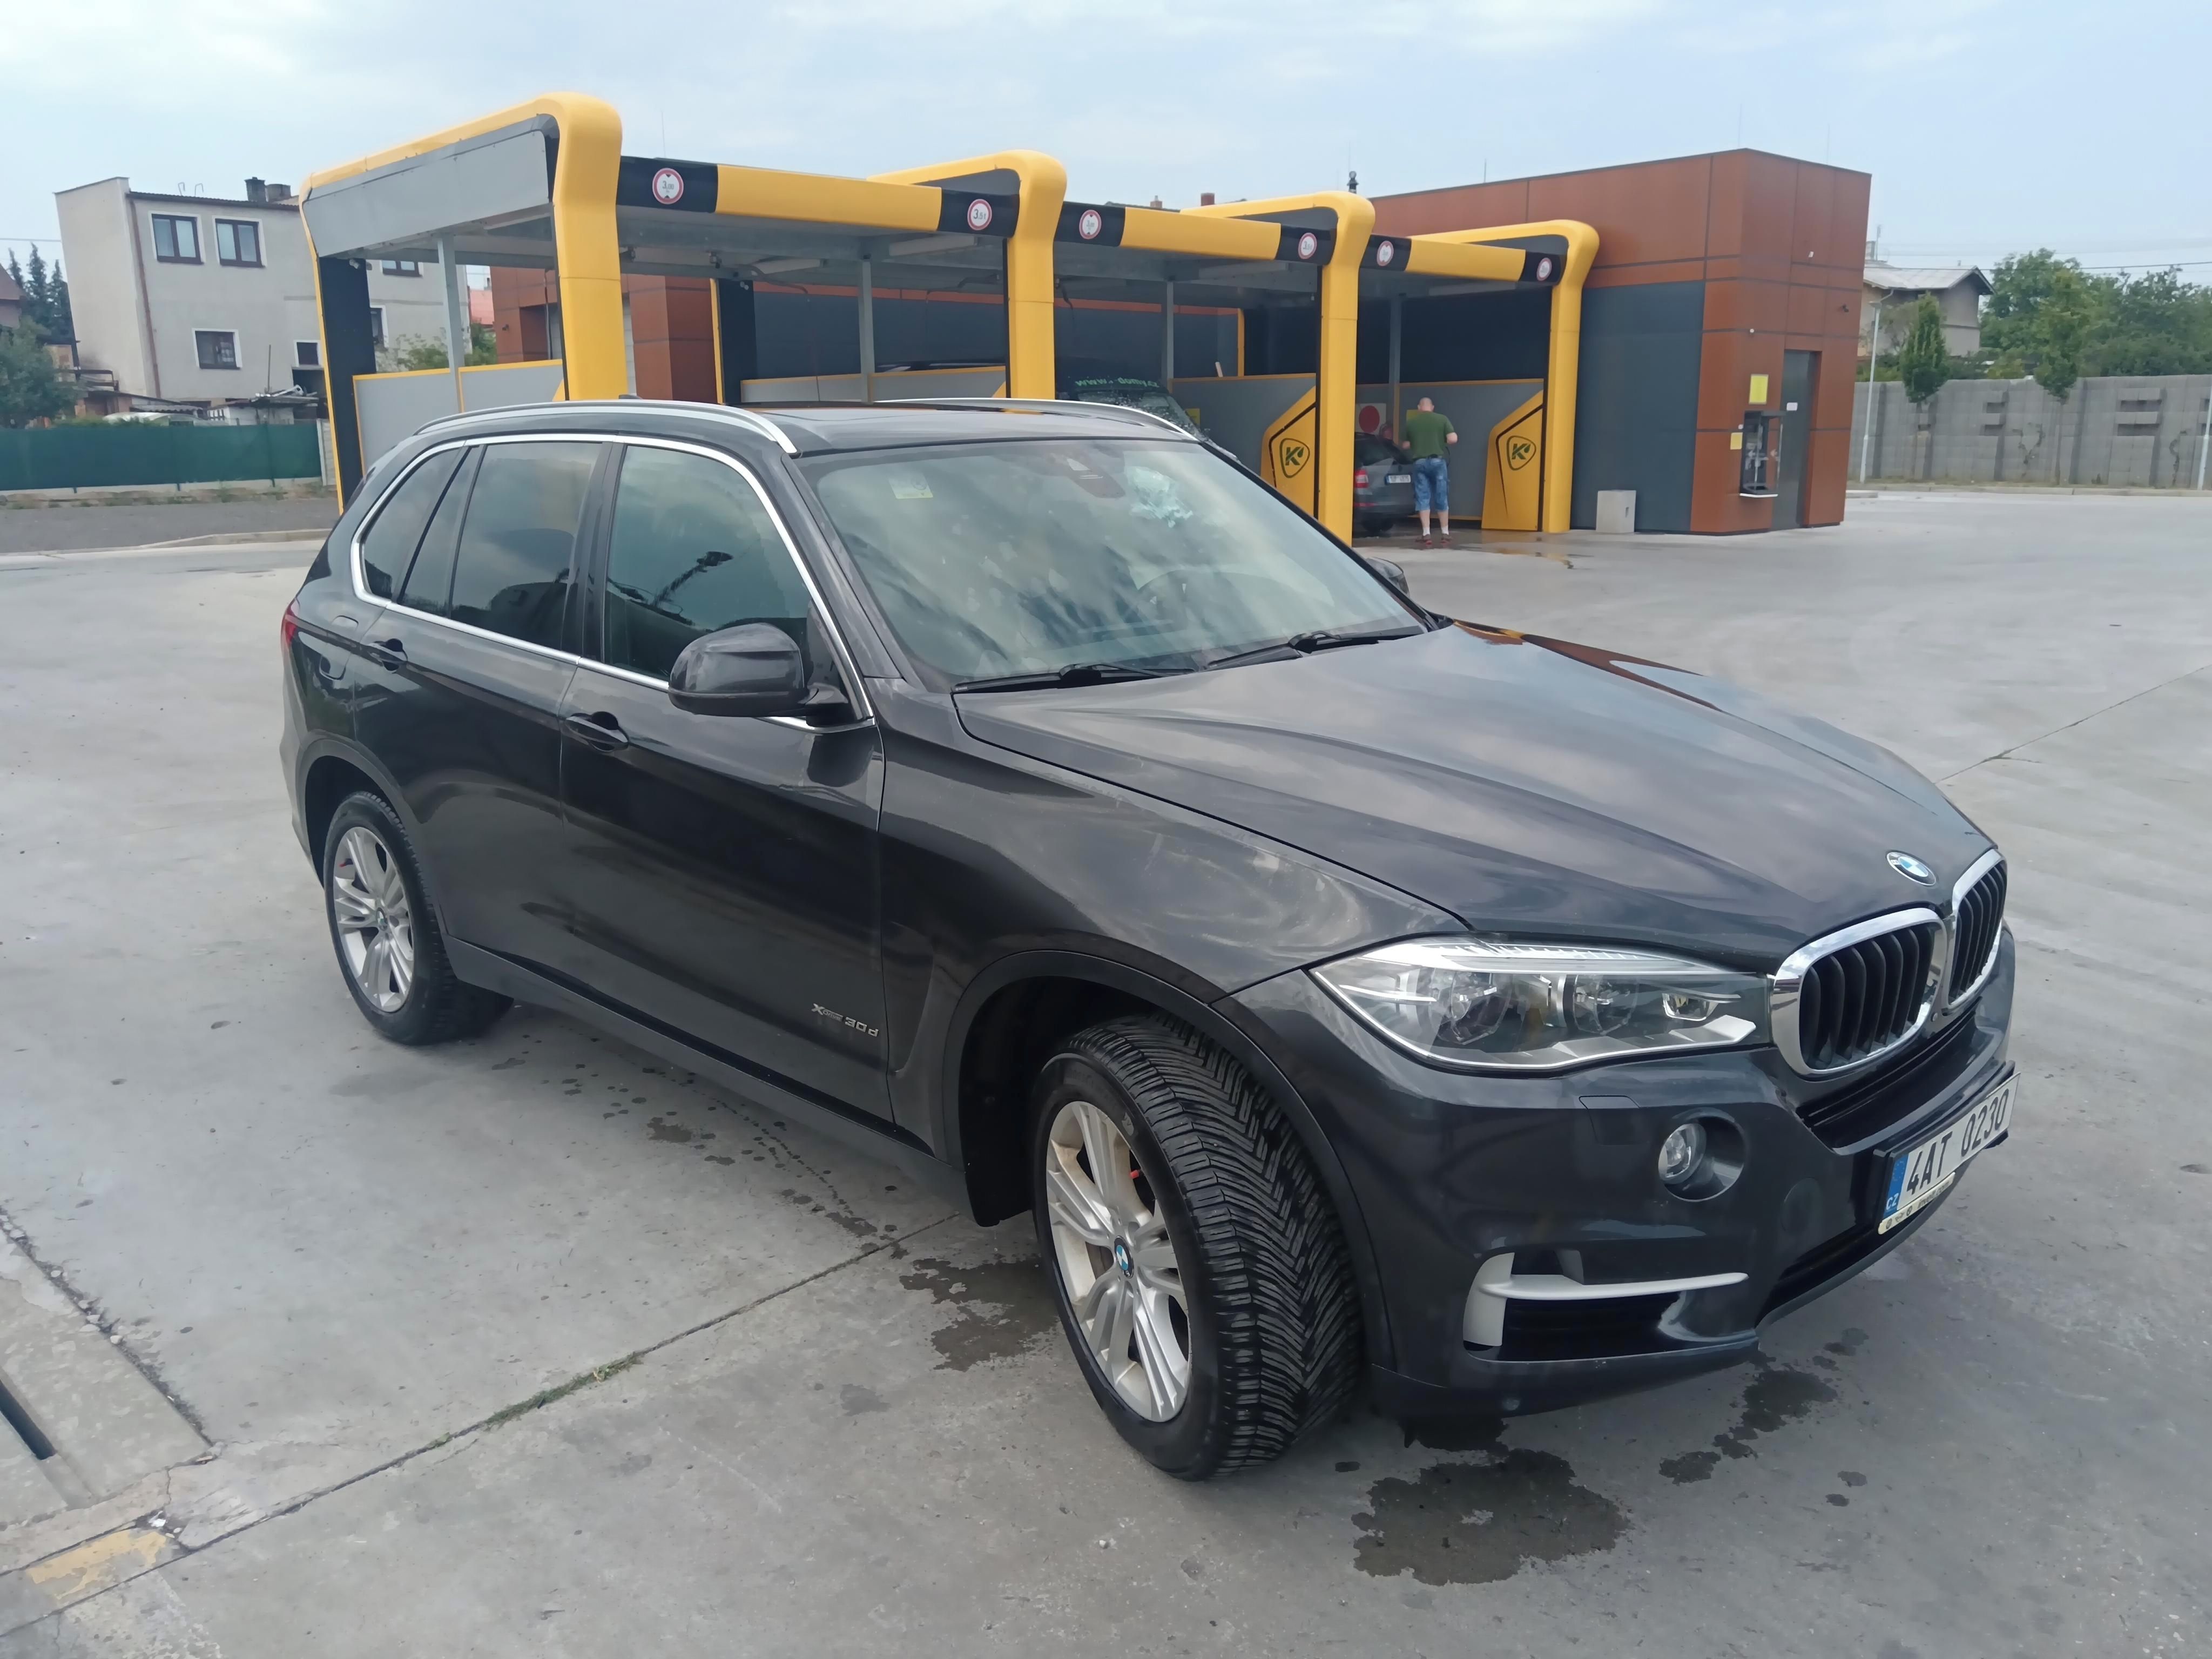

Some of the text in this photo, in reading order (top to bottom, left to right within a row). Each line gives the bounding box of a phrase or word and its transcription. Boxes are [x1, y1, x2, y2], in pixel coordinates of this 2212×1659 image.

[1906, 1088, 2009, 1195] 4AT 0230
[1886, 1192, 1899, 1211] CZ
